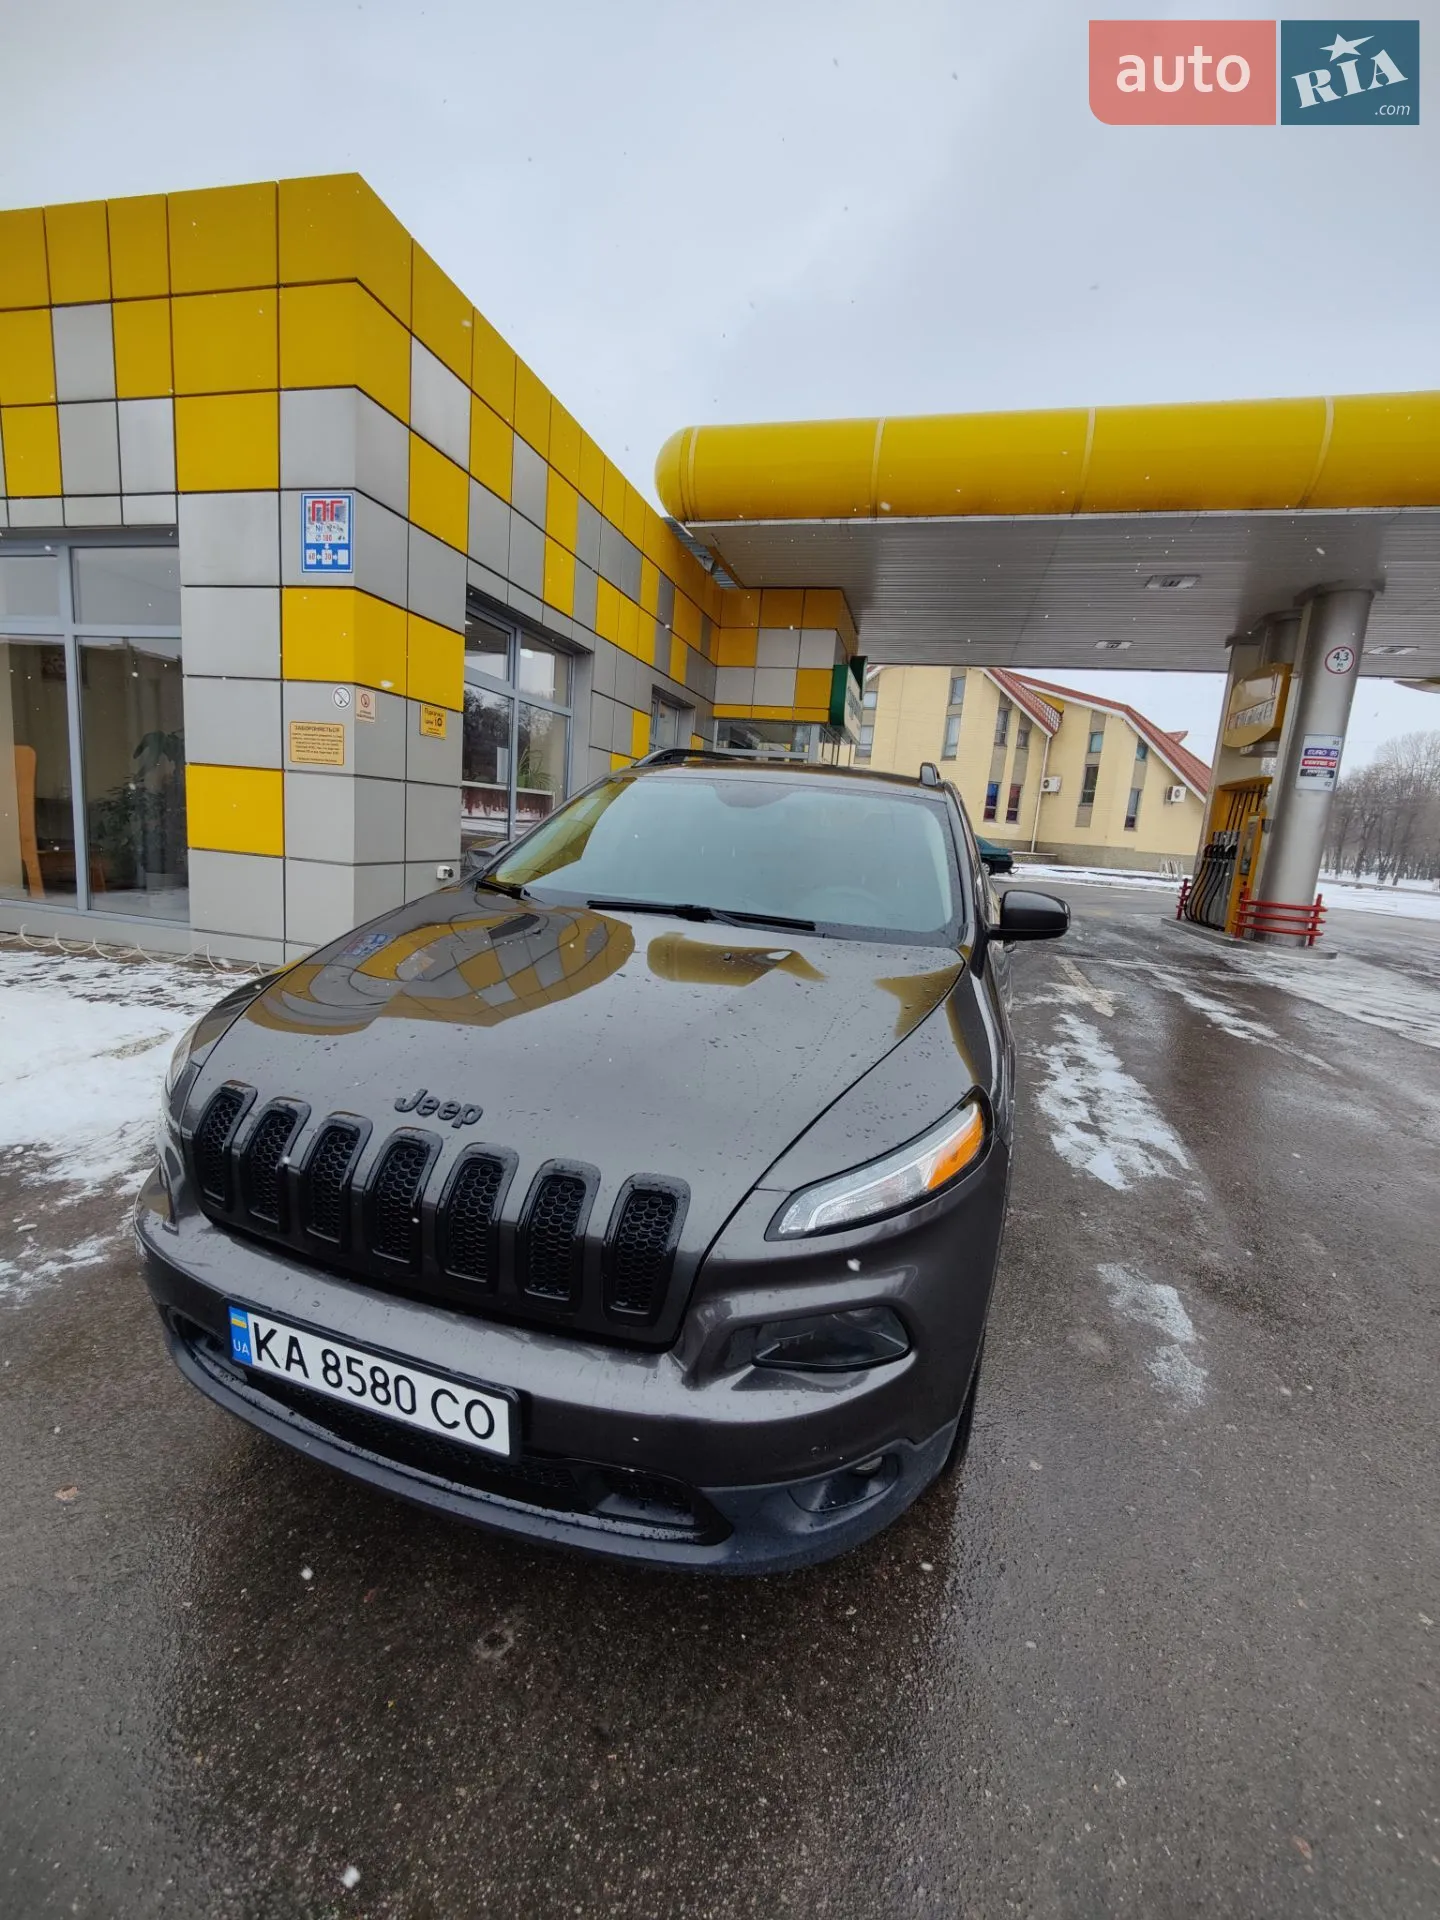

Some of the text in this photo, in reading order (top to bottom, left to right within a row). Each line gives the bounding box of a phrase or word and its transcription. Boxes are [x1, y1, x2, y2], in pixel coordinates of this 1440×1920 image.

[394, 1088, 484, 1129] Jeep
[232, 1337, 250, 1357] UA
[253, 1321, 495, 1440] KA 8580 CO
